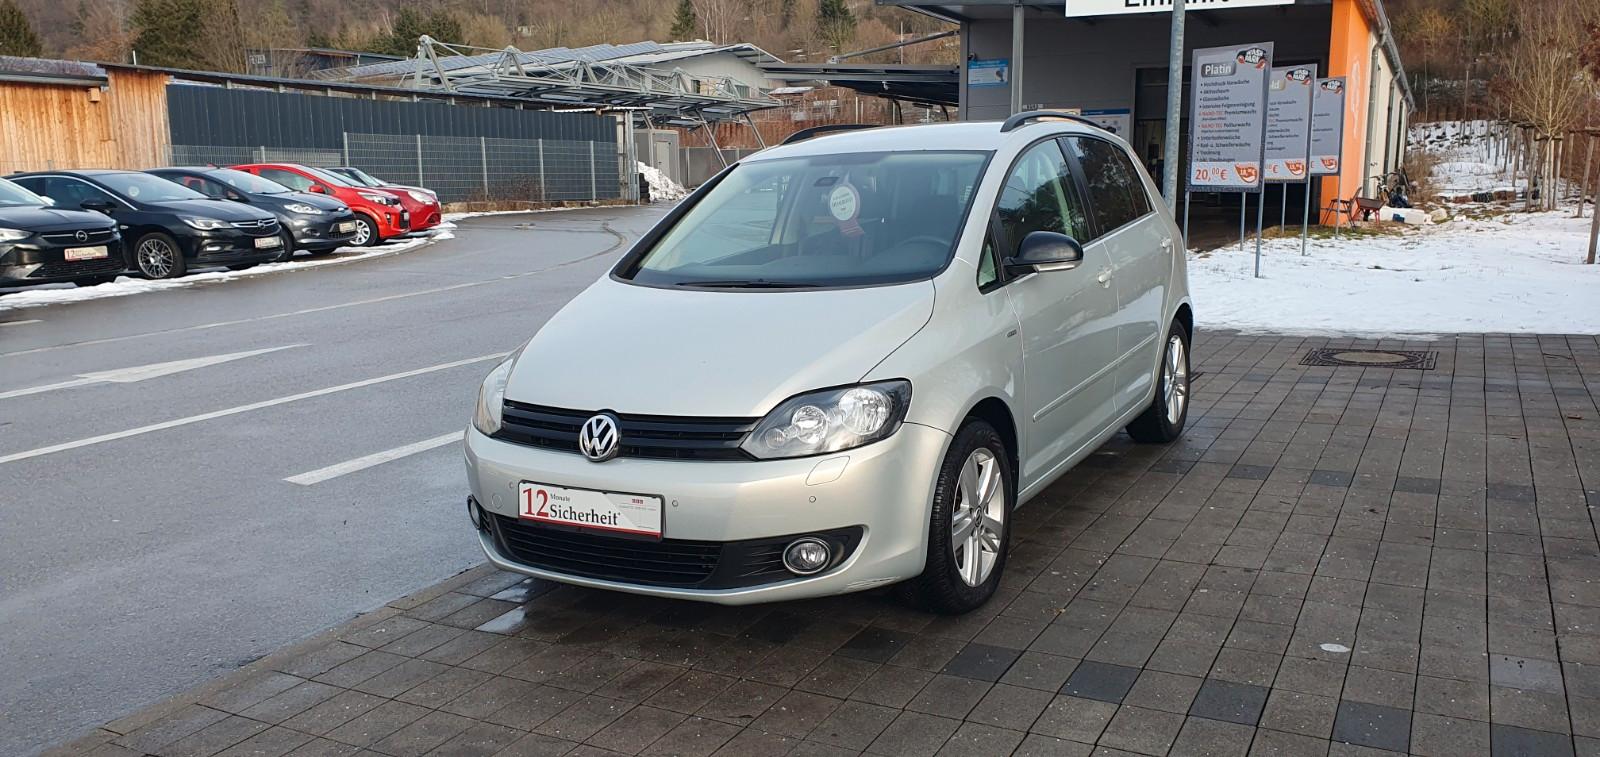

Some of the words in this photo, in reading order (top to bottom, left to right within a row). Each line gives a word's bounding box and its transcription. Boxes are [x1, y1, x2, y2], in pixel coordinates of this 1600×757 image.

[1246, 48, 1263, 57] WASH
[1205, 64, 1232, 75] Platin
[523, 488, 549, 517] 12
